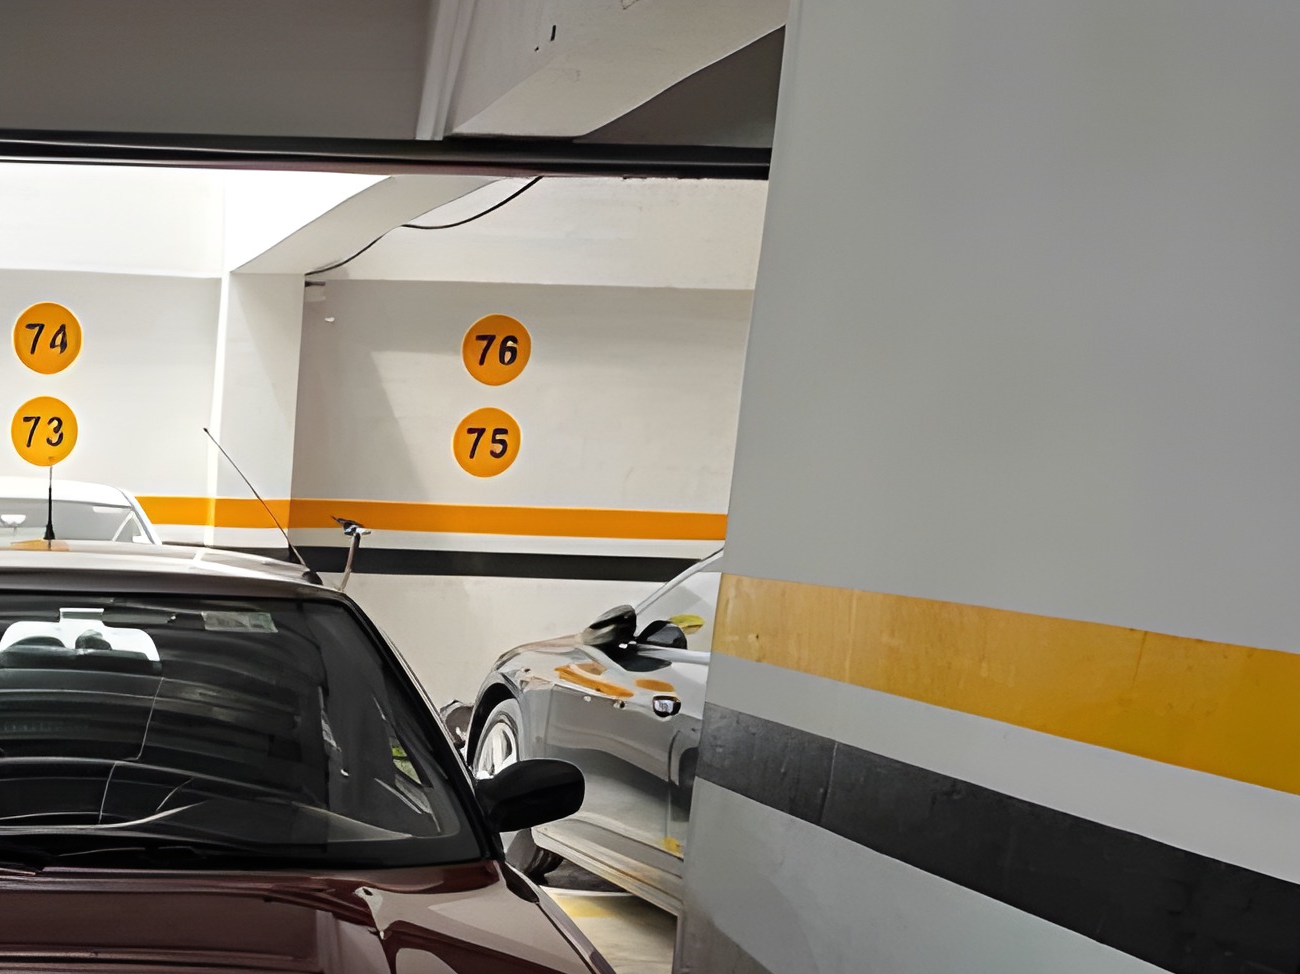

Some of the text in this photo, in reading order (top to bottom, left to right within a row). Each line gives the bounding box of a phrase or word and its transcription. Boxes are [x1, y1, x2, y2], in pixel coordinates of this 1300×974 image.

[25, 323, 68, 355] 74
[475, 334, 519, 366] 76
[22, 416, 64, 448] 73
[466, 427, 509, 459] 75
